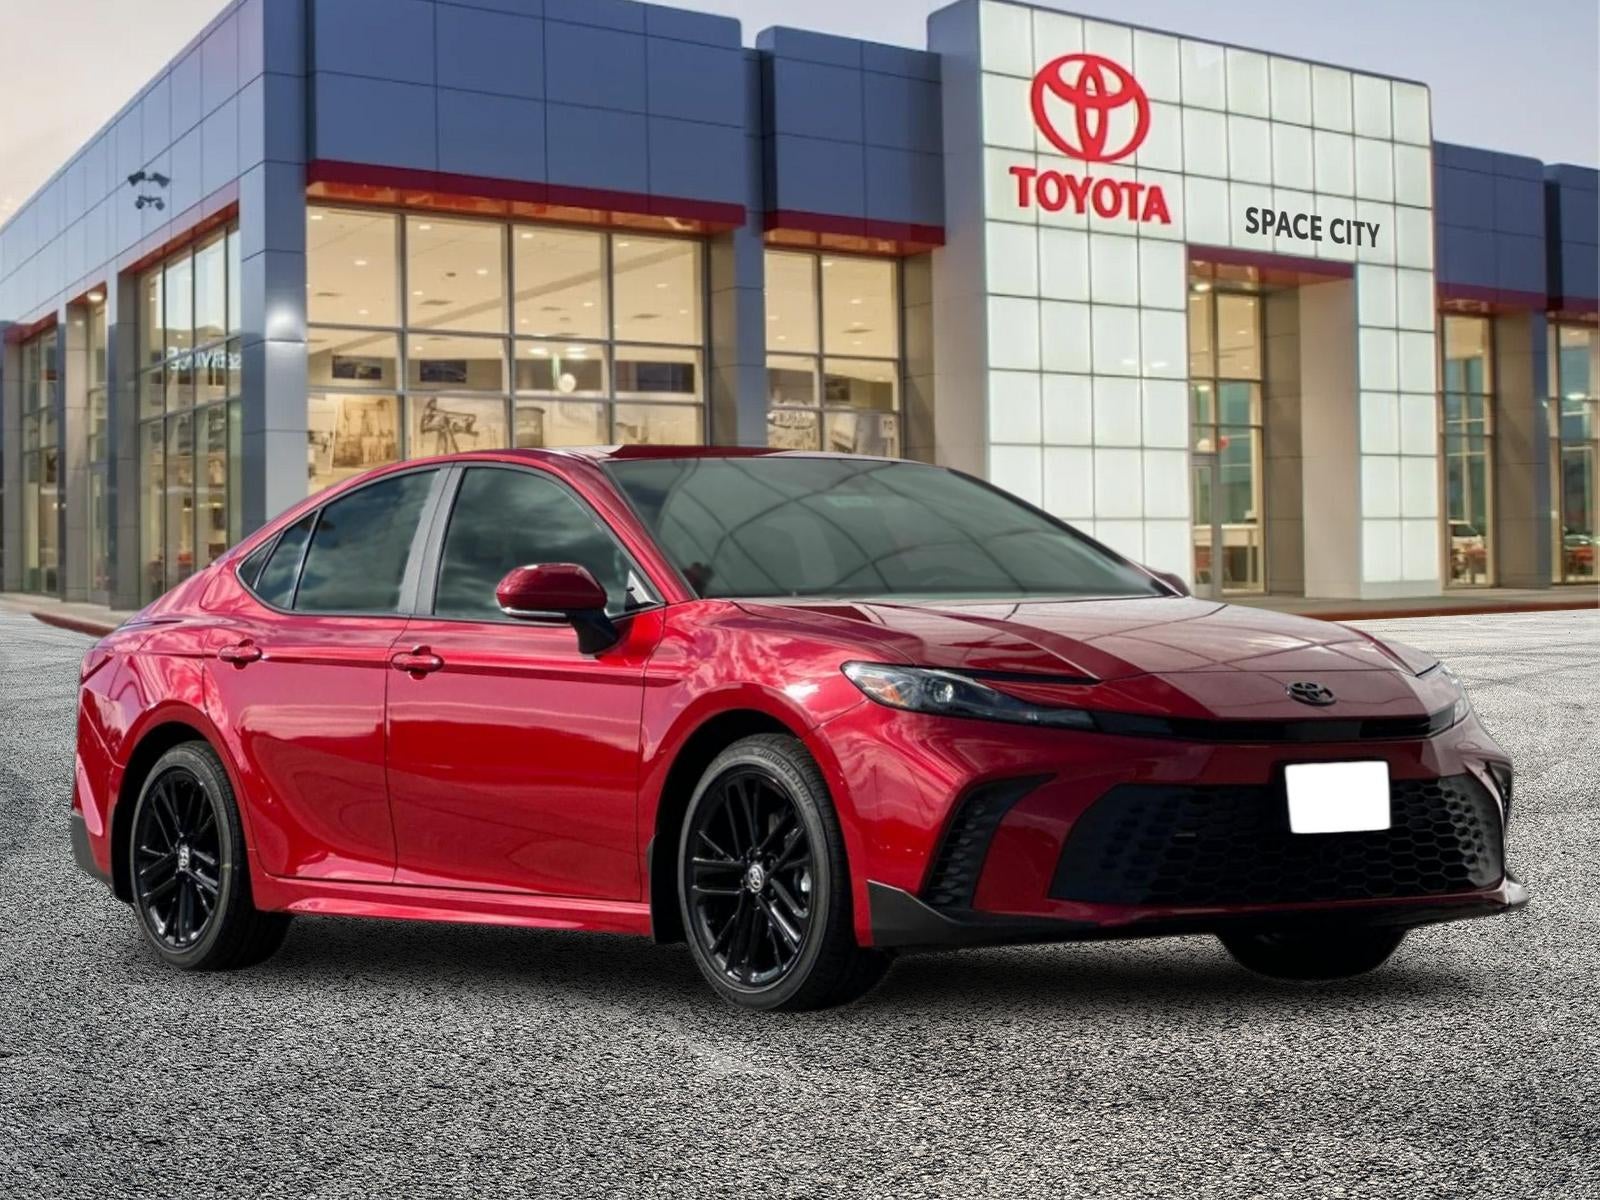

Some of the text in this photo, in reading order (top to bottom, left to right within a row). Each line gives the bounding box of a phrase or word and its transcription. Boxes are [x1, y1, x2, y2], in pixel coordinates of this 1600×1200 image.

[1009, 166, 1171, 224] TOYOTA
[1245, 206, 1380, 248] SPACE CITY
